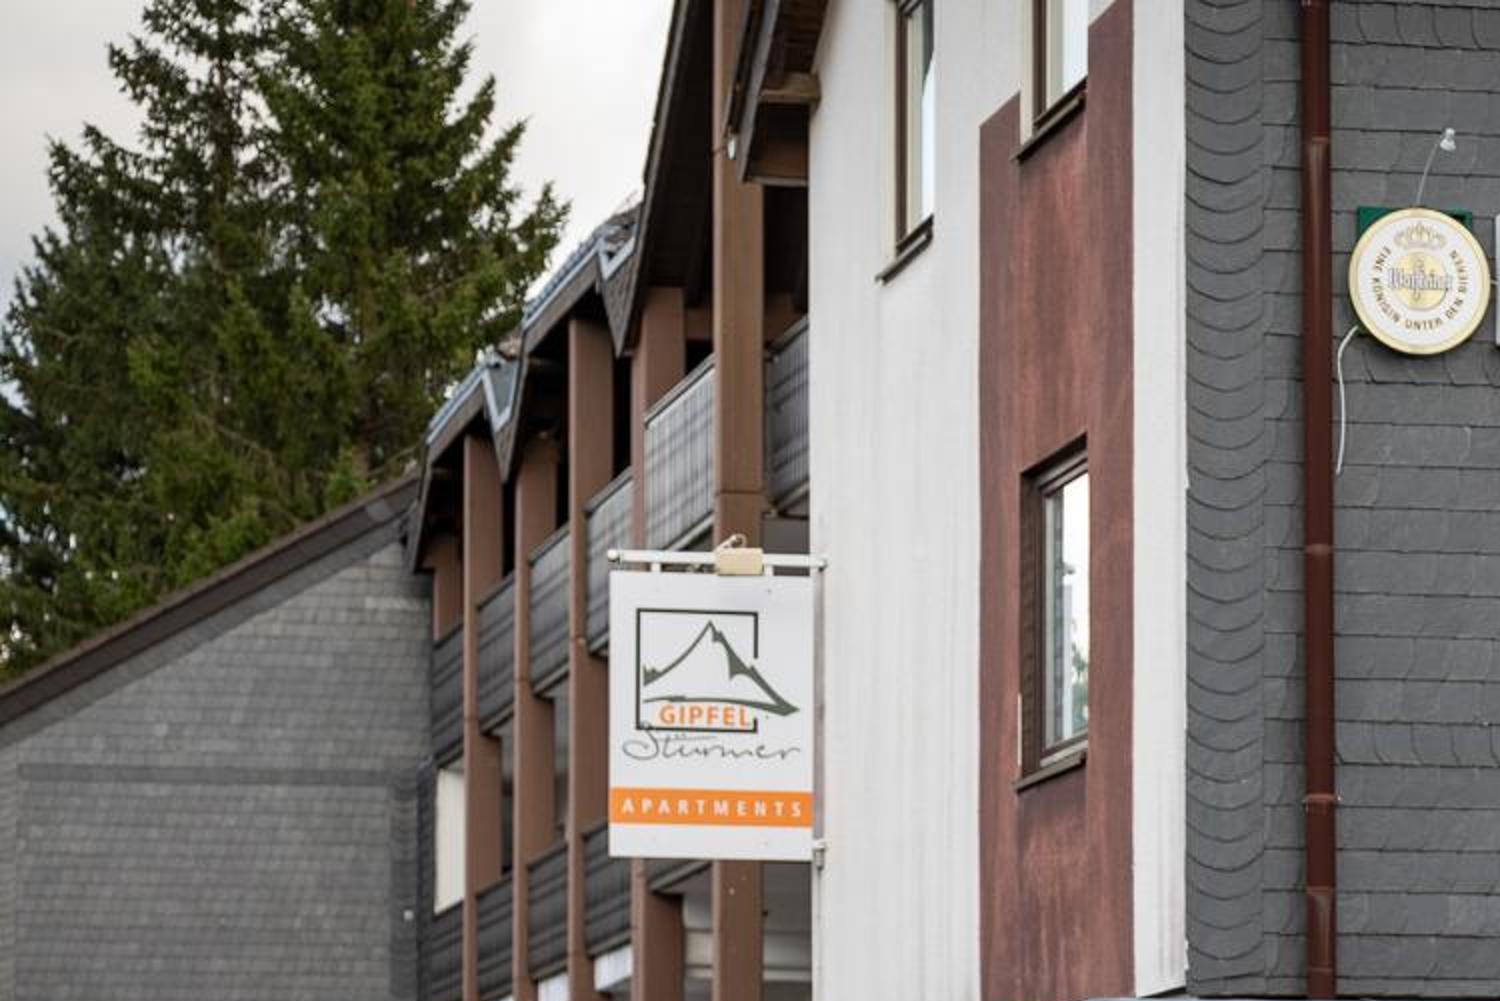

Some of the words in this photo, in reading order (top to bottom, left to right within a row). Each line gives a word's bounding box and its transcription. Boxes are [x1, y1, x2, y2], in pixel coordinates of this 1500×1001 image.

[659, 704, 751, 727] GIPFEL
[622, 720, 801, 761] Stürmer
[622, 797, 802, 817] APARTMENTS
